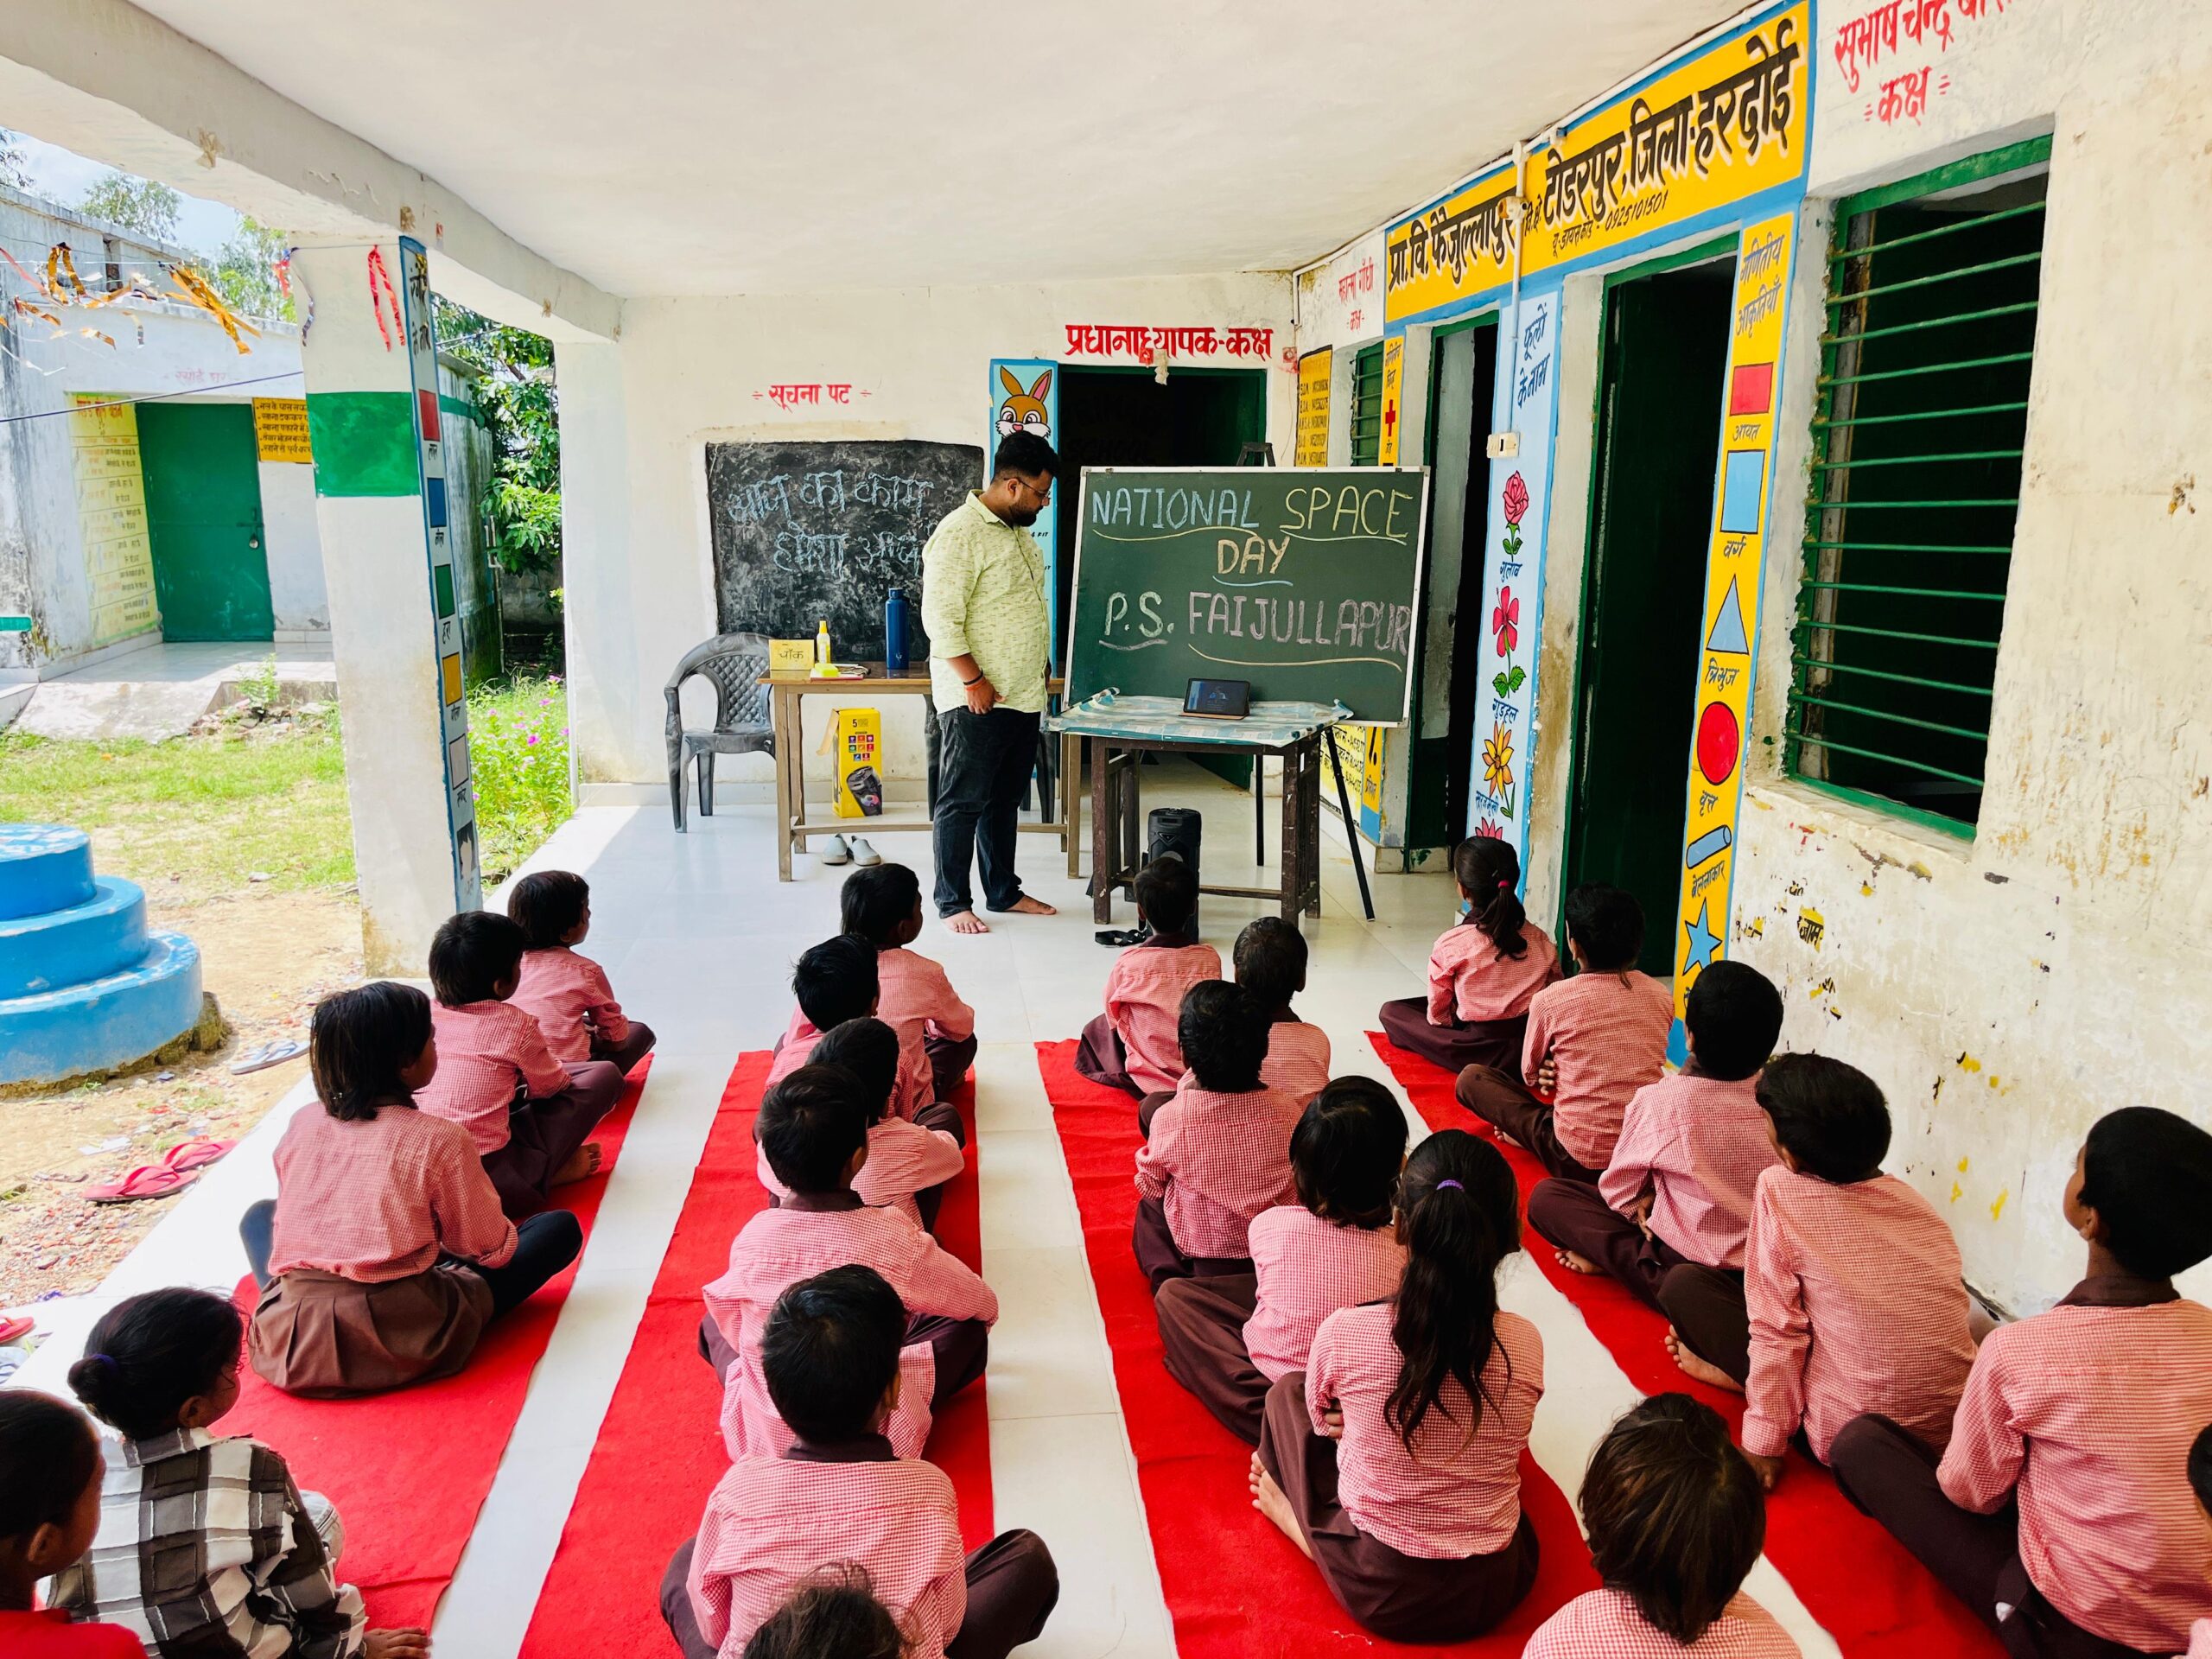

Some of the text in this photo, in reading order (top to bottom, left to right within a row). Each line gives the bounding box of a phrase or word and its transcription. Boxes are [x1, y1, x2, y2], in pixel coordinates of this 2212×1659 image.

[1834, 3, 1901, 93] सुभाष
[1878, 66, 1932, 125] कक्ष
[768, 384, 852, 413] सूचना पट
[1732, 423, 1762, 442] आयत
[1092, 485, 1414, 539] NATIONAL SPACE
[1217, 536, 1291, 575] DAY
[1723, 535, 1746, 559] वर्ग
[1500, 561, 1522, 582] गुलाब
[1103, 591, 1412, 656] P.S. FAIJULLAPUR
[1704, 657, 1739, 692] त्रिभुज
[852, 718, 858, 728] 5
